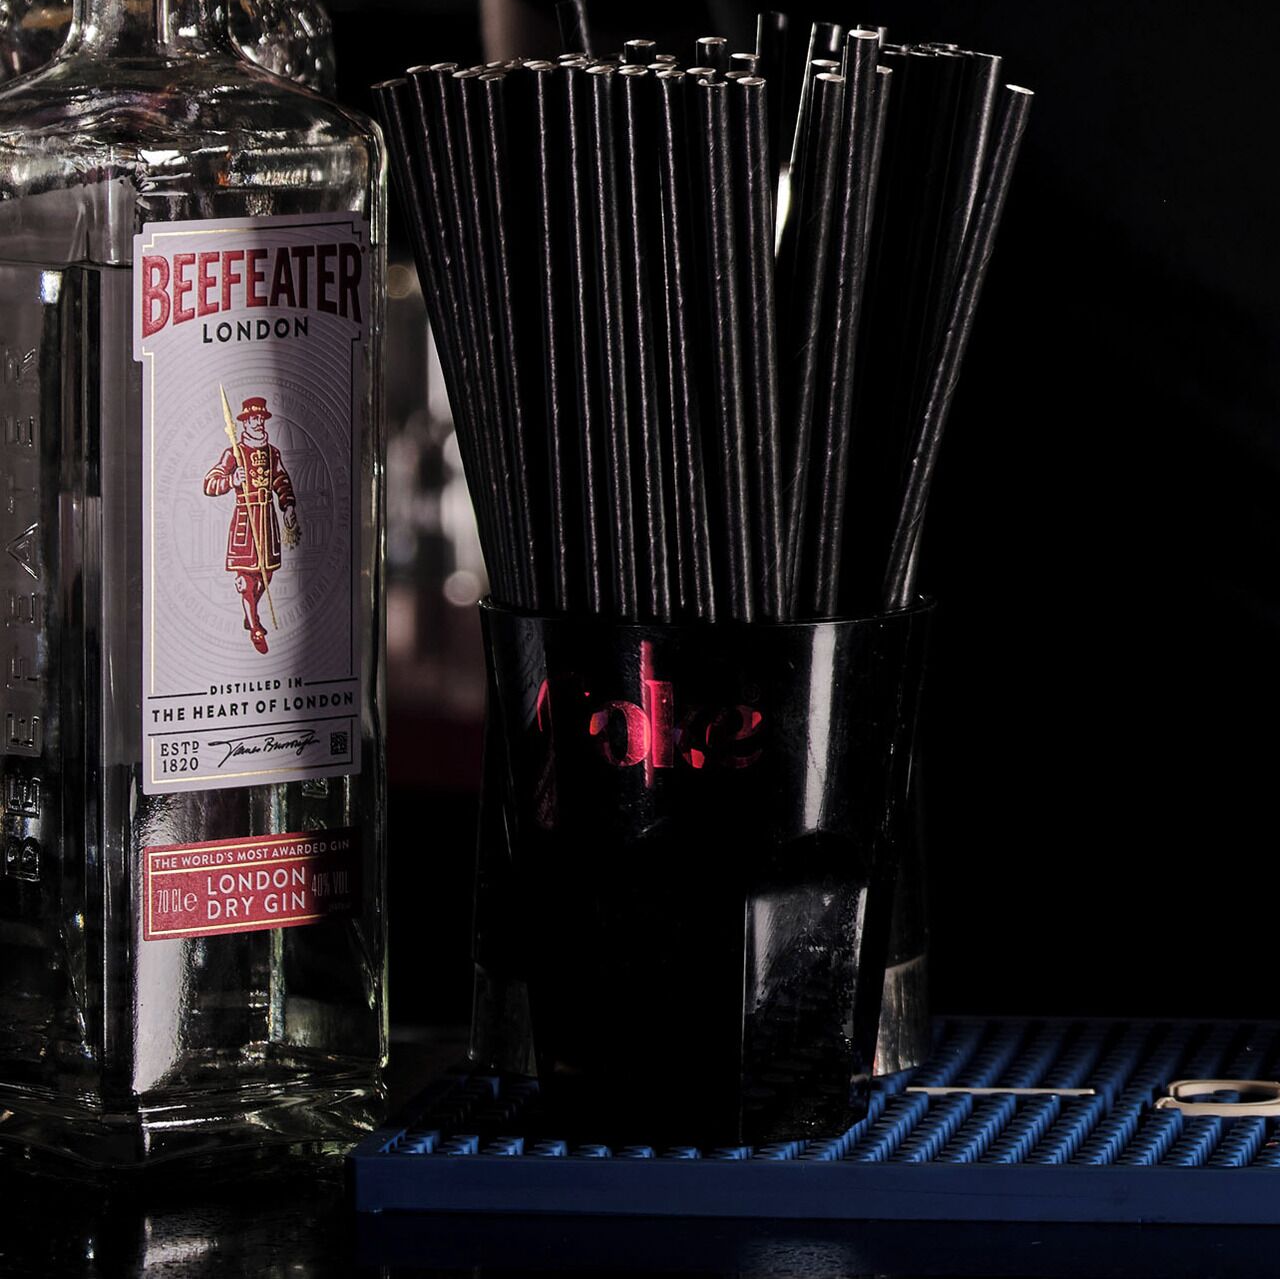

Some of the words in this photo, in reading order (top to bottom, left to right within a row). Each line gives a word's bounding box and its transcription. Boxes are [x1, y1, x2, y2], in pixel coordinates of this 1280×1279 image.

[142, 242, 363, 340] BEEFEATER
[202, 317, 309, 344] LONDON
[209, 678, 281, 696] DISTILLED
[288, 677, 302, 689] IN
[152, 708, 185, 723] THE
[193, 701, 249, 721] HEART
[255, 698, 277, 714] OF
[283, 691, 353, 712] LONDON
[162, 757, 199, 773] 1820
[154, 858, 177, 870] THE
[182, 852, 234, 867] WORLD'S
[237, 848, 269, 863] MOST
[271, 841, 327, 858] AWARDED
[207, 867, 306, 896] LONDON
[157, 889, 169, 914] 70
[207, 896, 254, 920] DRY
[264, 891, 306, 914] GIN
